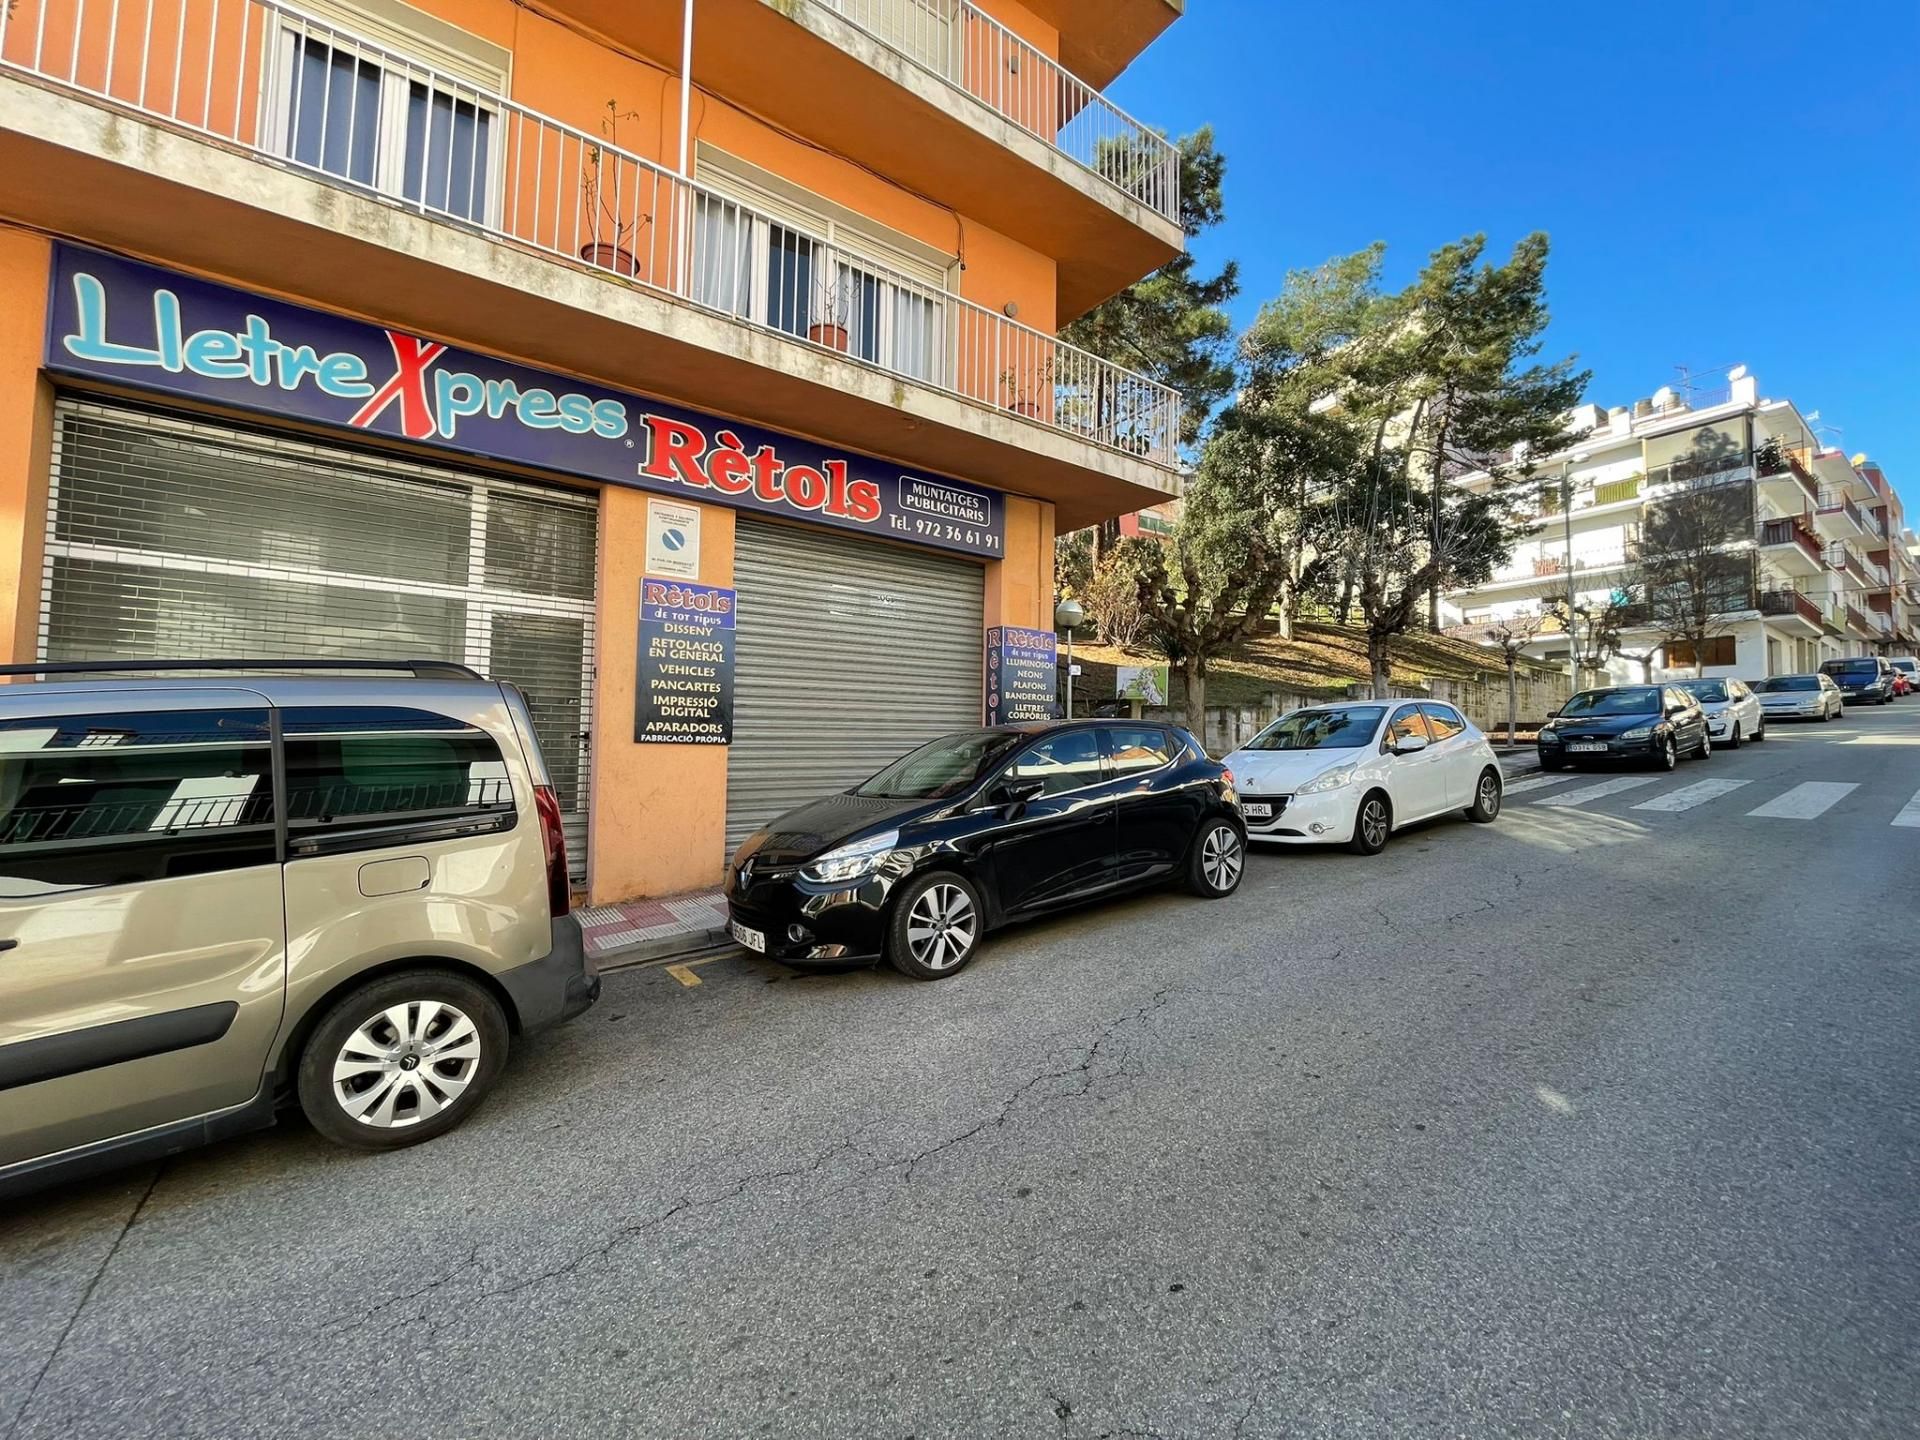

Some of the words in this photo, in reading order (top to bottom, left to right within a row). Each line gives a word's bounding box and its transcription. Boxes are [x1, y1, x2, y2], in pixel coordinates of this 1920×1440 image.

[638, 413, 882, 522] Rètols
[912, 483, 979, 508] MUNTATGES
[906, 495, 984, 522] PUBLICITARIS
[916, 519, 941, 538] 972
[945, 525, 962, 542] 36
[966, 530, 980, 545] 61
[985, 534, 999, 549] 91
[644, 582, 731, 613] Rètols
[664, 623, 713, 637] DISSENY
[652, 637, 723, 653] RETOLACIÓ
[1005, 629, 1053, 651] Rètols
[649, 647, 666, 657] EN
[669, 649, 725, 662] GENERAL
[659, 663, 716, 677] VEHICLES
[1006, 658, 1054, 670] LLUMINOSOS
[1017, 669, 1043, 679] NEONS
[651, 679, 721, 693] PANCARTES
[1013, 681, 1047, 690] PLAFONS
[653, 695, 718, 708] IMPRESSIÓ
[1005, 692, 1053, 702] BANDEROLES
[661, 706, 711, 718] DIGITAL
[1015, 704, 1044, 712] LLETRES
[646, 721, 723, 734] APARADORS
[641, 733, 693, 742] FABRICACIÓ
[695, 734, 727, 743] PRÒPIA
[1252, 806, 1270, 815] HRL
